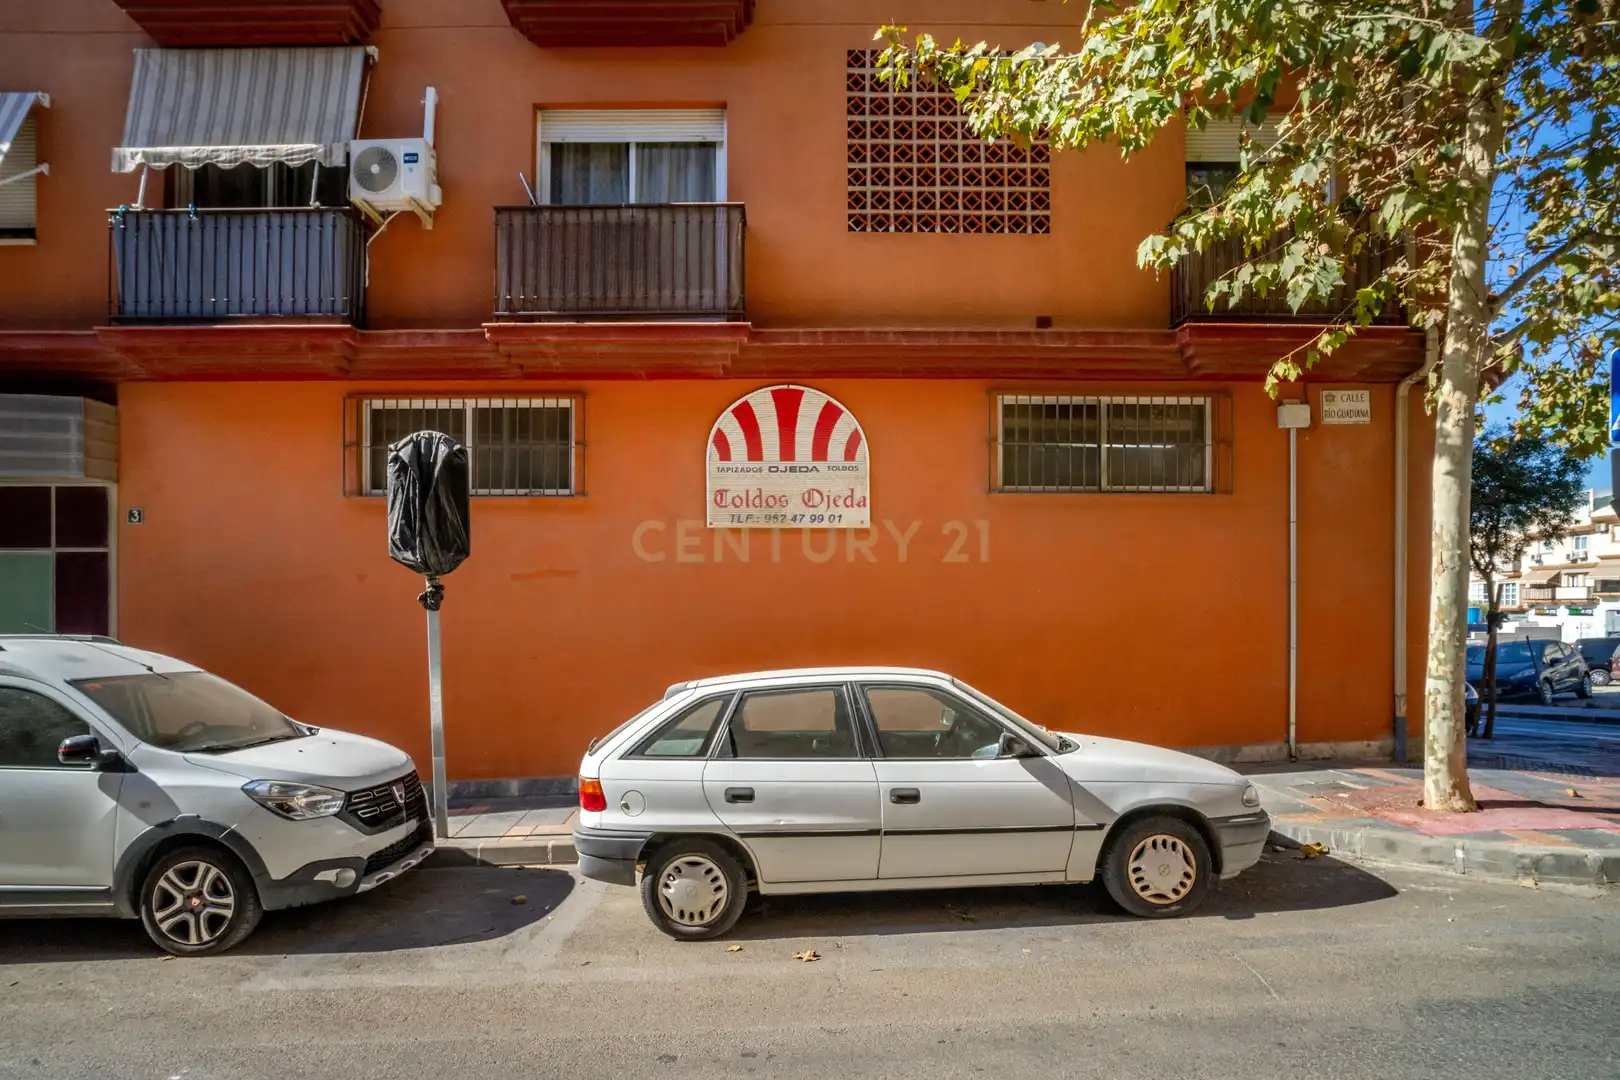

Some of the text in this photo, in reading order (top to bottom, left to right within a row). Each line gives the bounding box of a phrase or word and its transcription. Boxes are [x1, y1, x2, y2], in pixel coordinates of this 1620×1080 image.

[1340, 393, 1365, 403] CALLE
[1336, 409, 1369, 419] GUADIANA
[768, 465, 820, 473] OJEDA
[713, 488, 867, 512] Toldos Ojeda
[131, 510, 139, 522] 3
[764, 514, 787, 523] 952
[790, 514, 806, 523] 47
[809, 514, 825, 523] 99
[828, 514, 843, 523] 01
